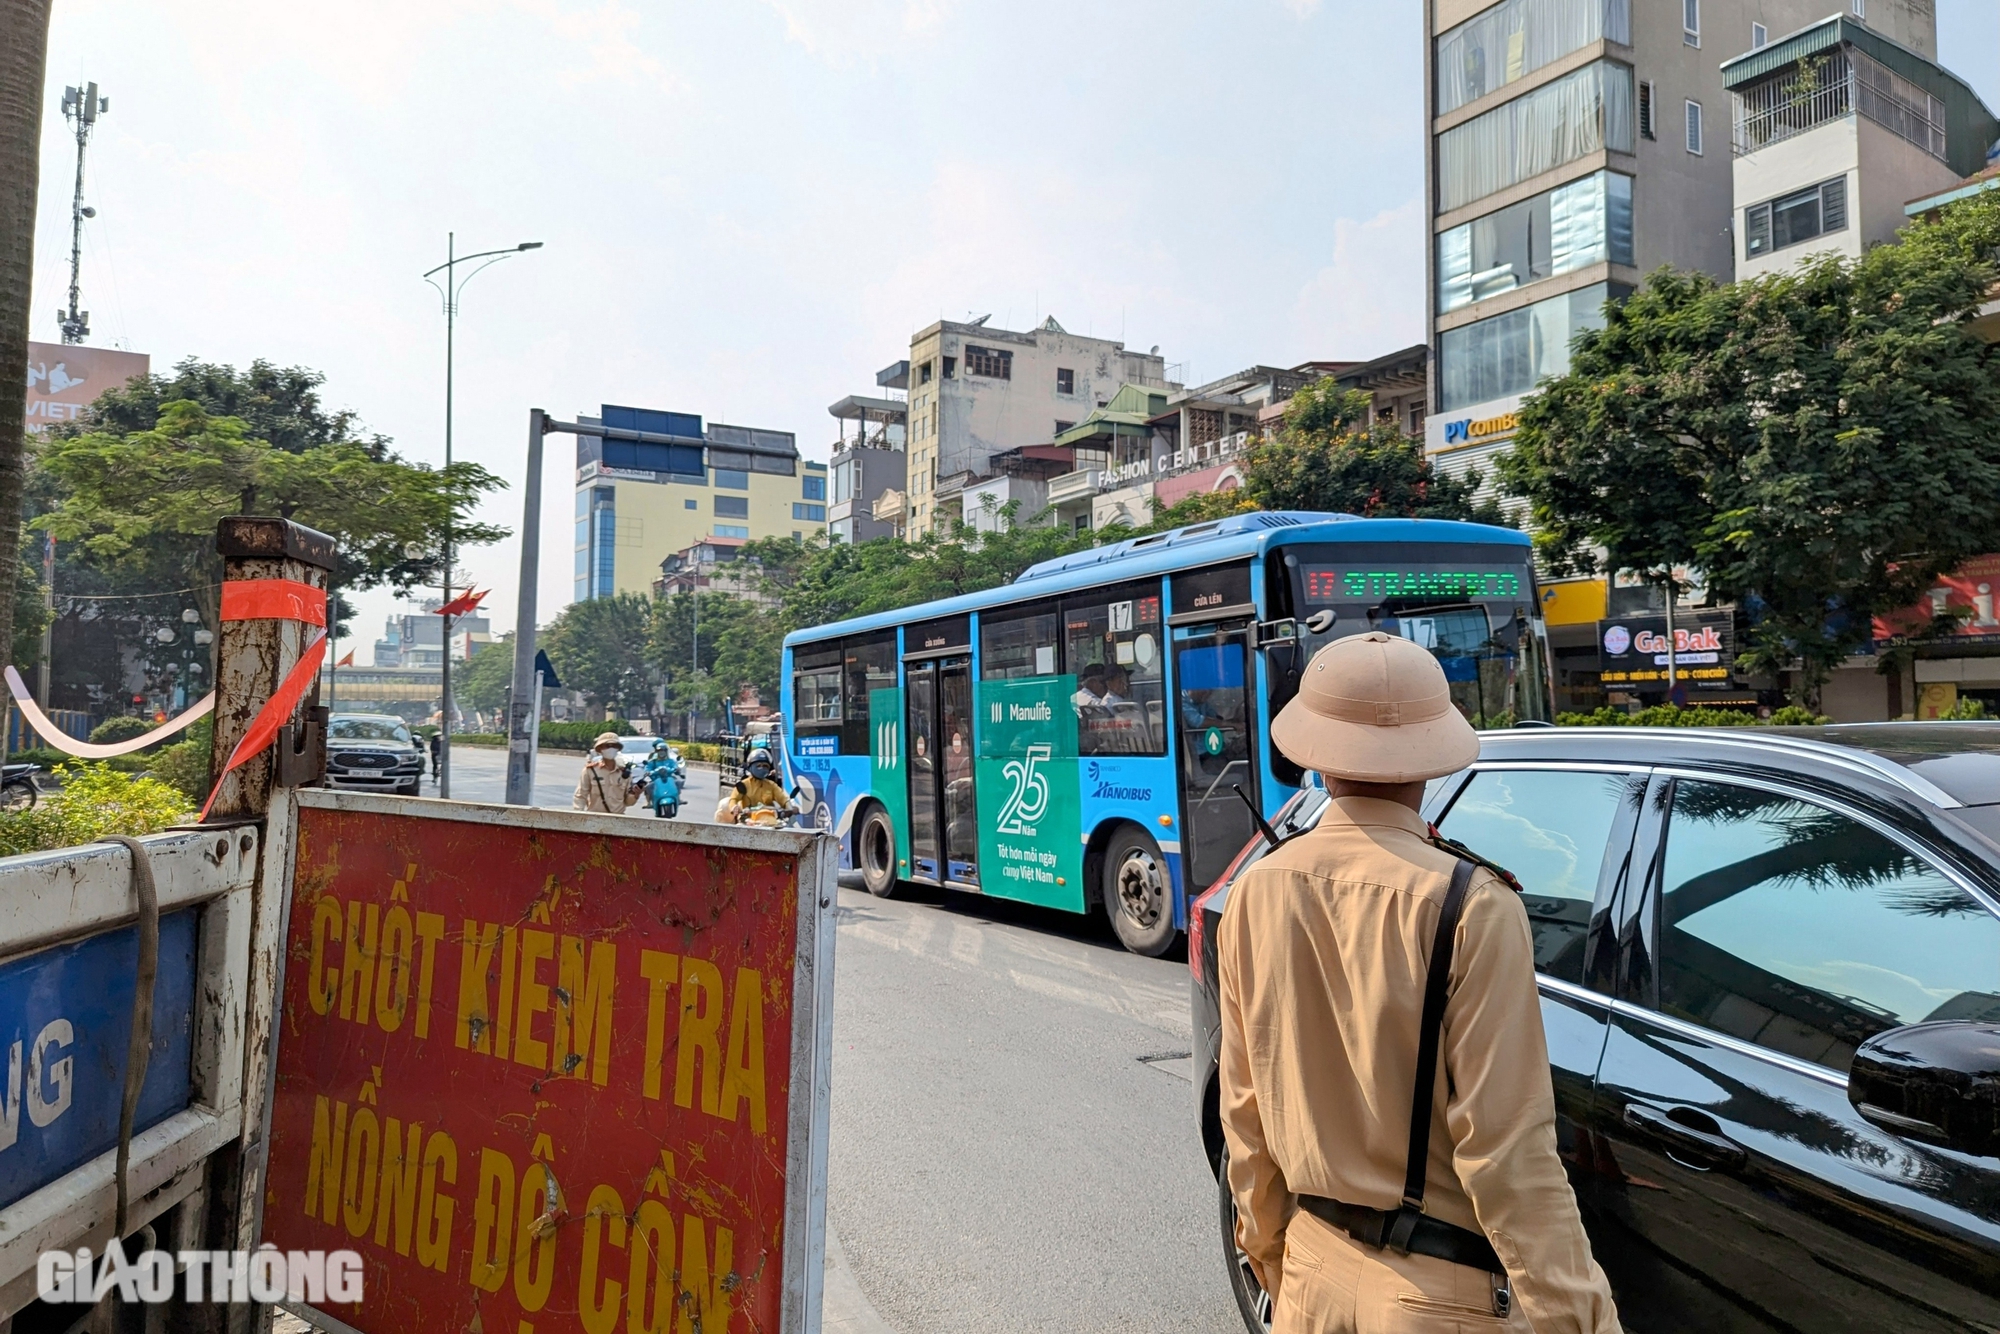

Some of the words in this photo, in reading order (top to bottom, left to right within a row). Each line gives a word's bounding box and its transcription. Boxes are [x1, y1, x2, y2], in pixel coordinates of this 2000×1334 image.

[1098, 459, 1150, 487] FASHION
[1158, 431, 1248, 473] CENTER
[1310, 572, 1335, 596] 17
[1112, 602, 1131, 631] 17
[1634, 630, 1667, 653] Ga
[1673, 626, 1722, 651] Bak
[1009, 701, 1052, 721] Manulife
[997, 745, 1052, 834] 25
[1091, 781, 1152, 801] HANOIBUS
[1021, 825, 1037, 836] Năm
[997, 844, 1009, 859] Tốt
[1009, 846, 1023, 861] hơn
[1023, 847, 1037, 862] mỗi
[1038, 850, 1057, 868] ngày
[1002, 862, 1019, 881] cùng
[1019, 865, 1035, 883] Việt
[1035, 867, 1054, 884] Nam
[308, 863, 445, 1040] CHỐT
[455, 874, 616, 1088] KIỂM
[640, 948, 768, 1135] TRA
[304, 1066, 458, 1274] NỒNG
[469, 1132, 568, 1334] ĐỘ
[578, 1149, 735, 1334] CỒN
